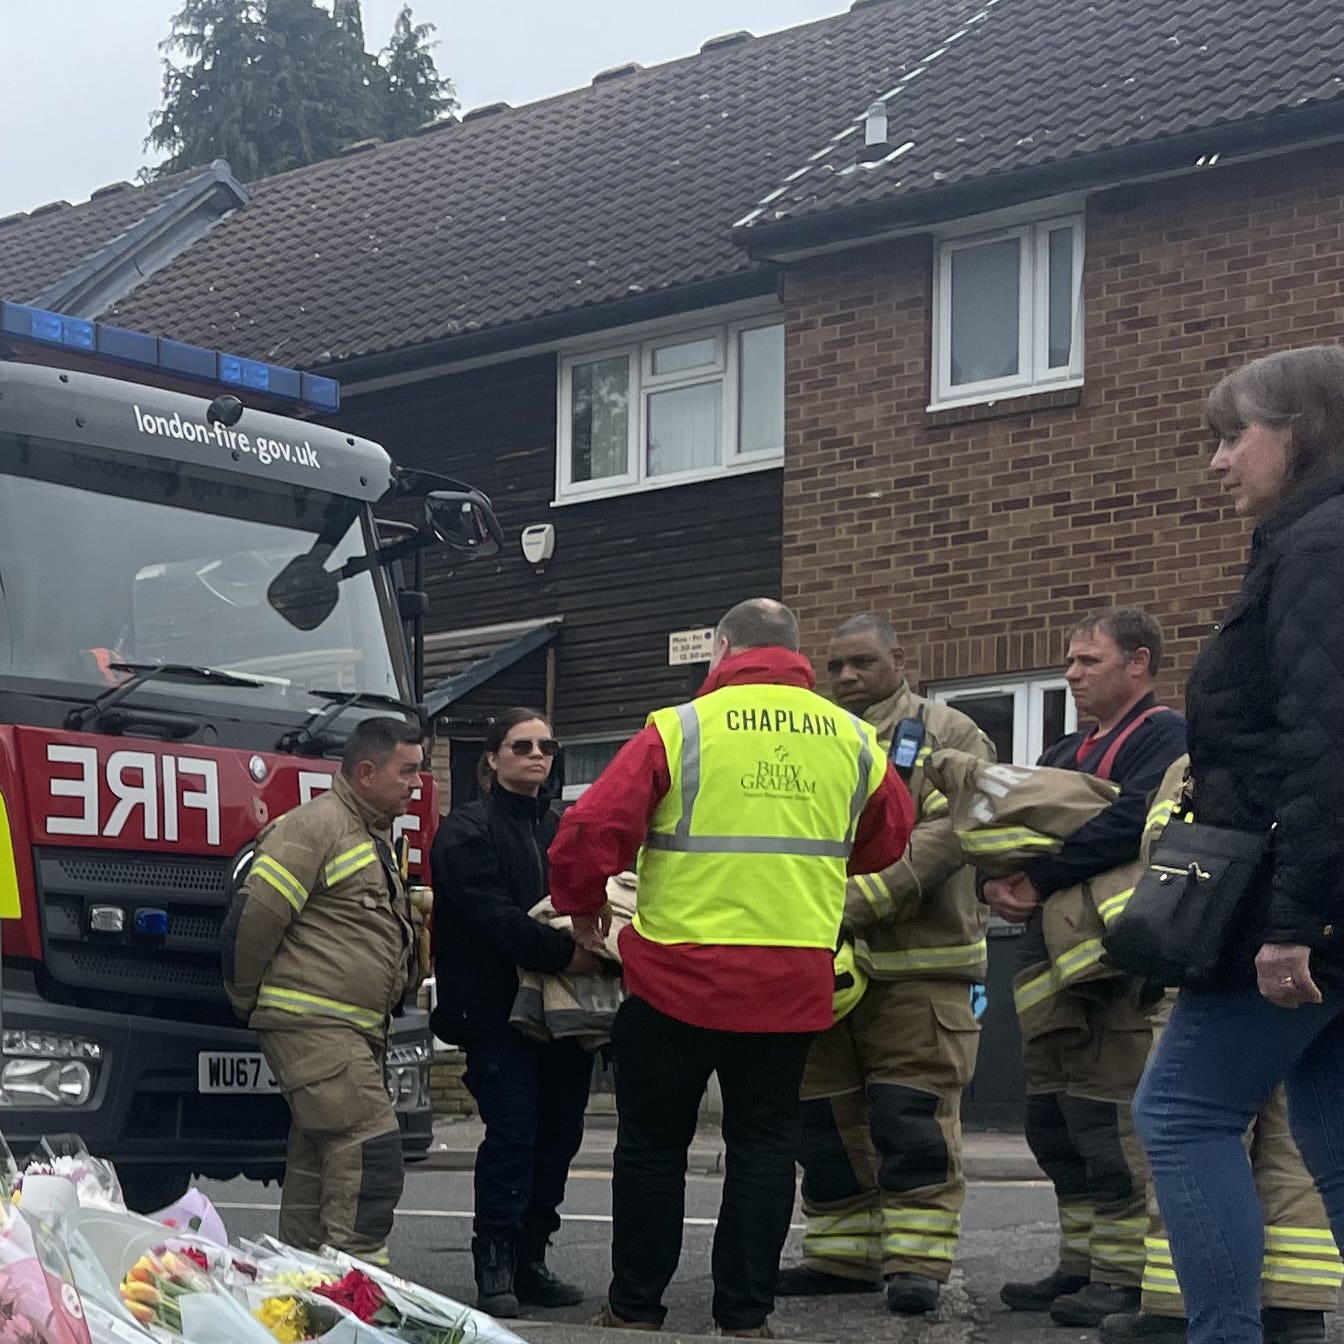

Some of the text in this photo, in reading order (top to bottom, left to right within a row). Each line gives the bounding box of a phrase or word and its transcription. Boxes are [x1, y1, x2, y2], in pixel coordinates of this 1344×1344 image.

[133, 405, 321, 469] london-fire.gov.uk
[726, 709, 837, 736] CHAPLAIN
[740, 774, 816, 794] GRAHAM
[208, 1057, 261, 1087] WU67
